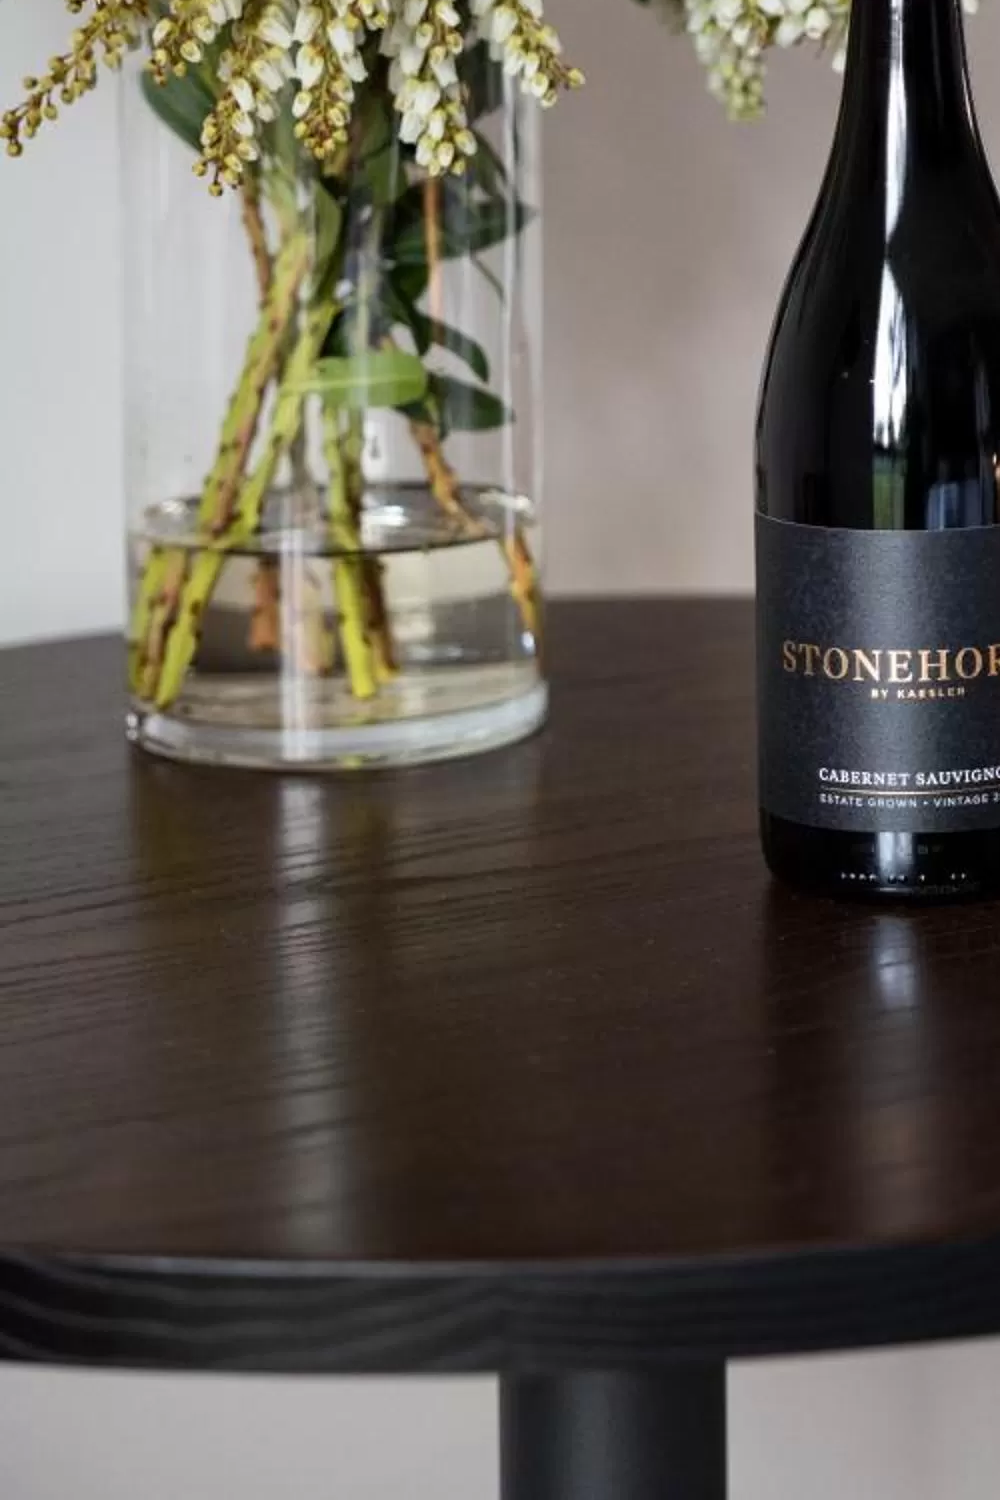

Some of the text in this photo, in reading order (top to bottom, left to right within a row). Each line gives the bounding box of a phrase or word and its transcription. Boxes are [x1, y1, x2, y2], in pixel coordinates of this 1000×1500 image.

[871, 687, 888, 699] BY
[819, 767, 909, 786] CABERNET
[820, 793, 863, 807] ESTATE
[868, 797, 917, 808] GROWN
[934, 793, 988, 808] VINTAGE
